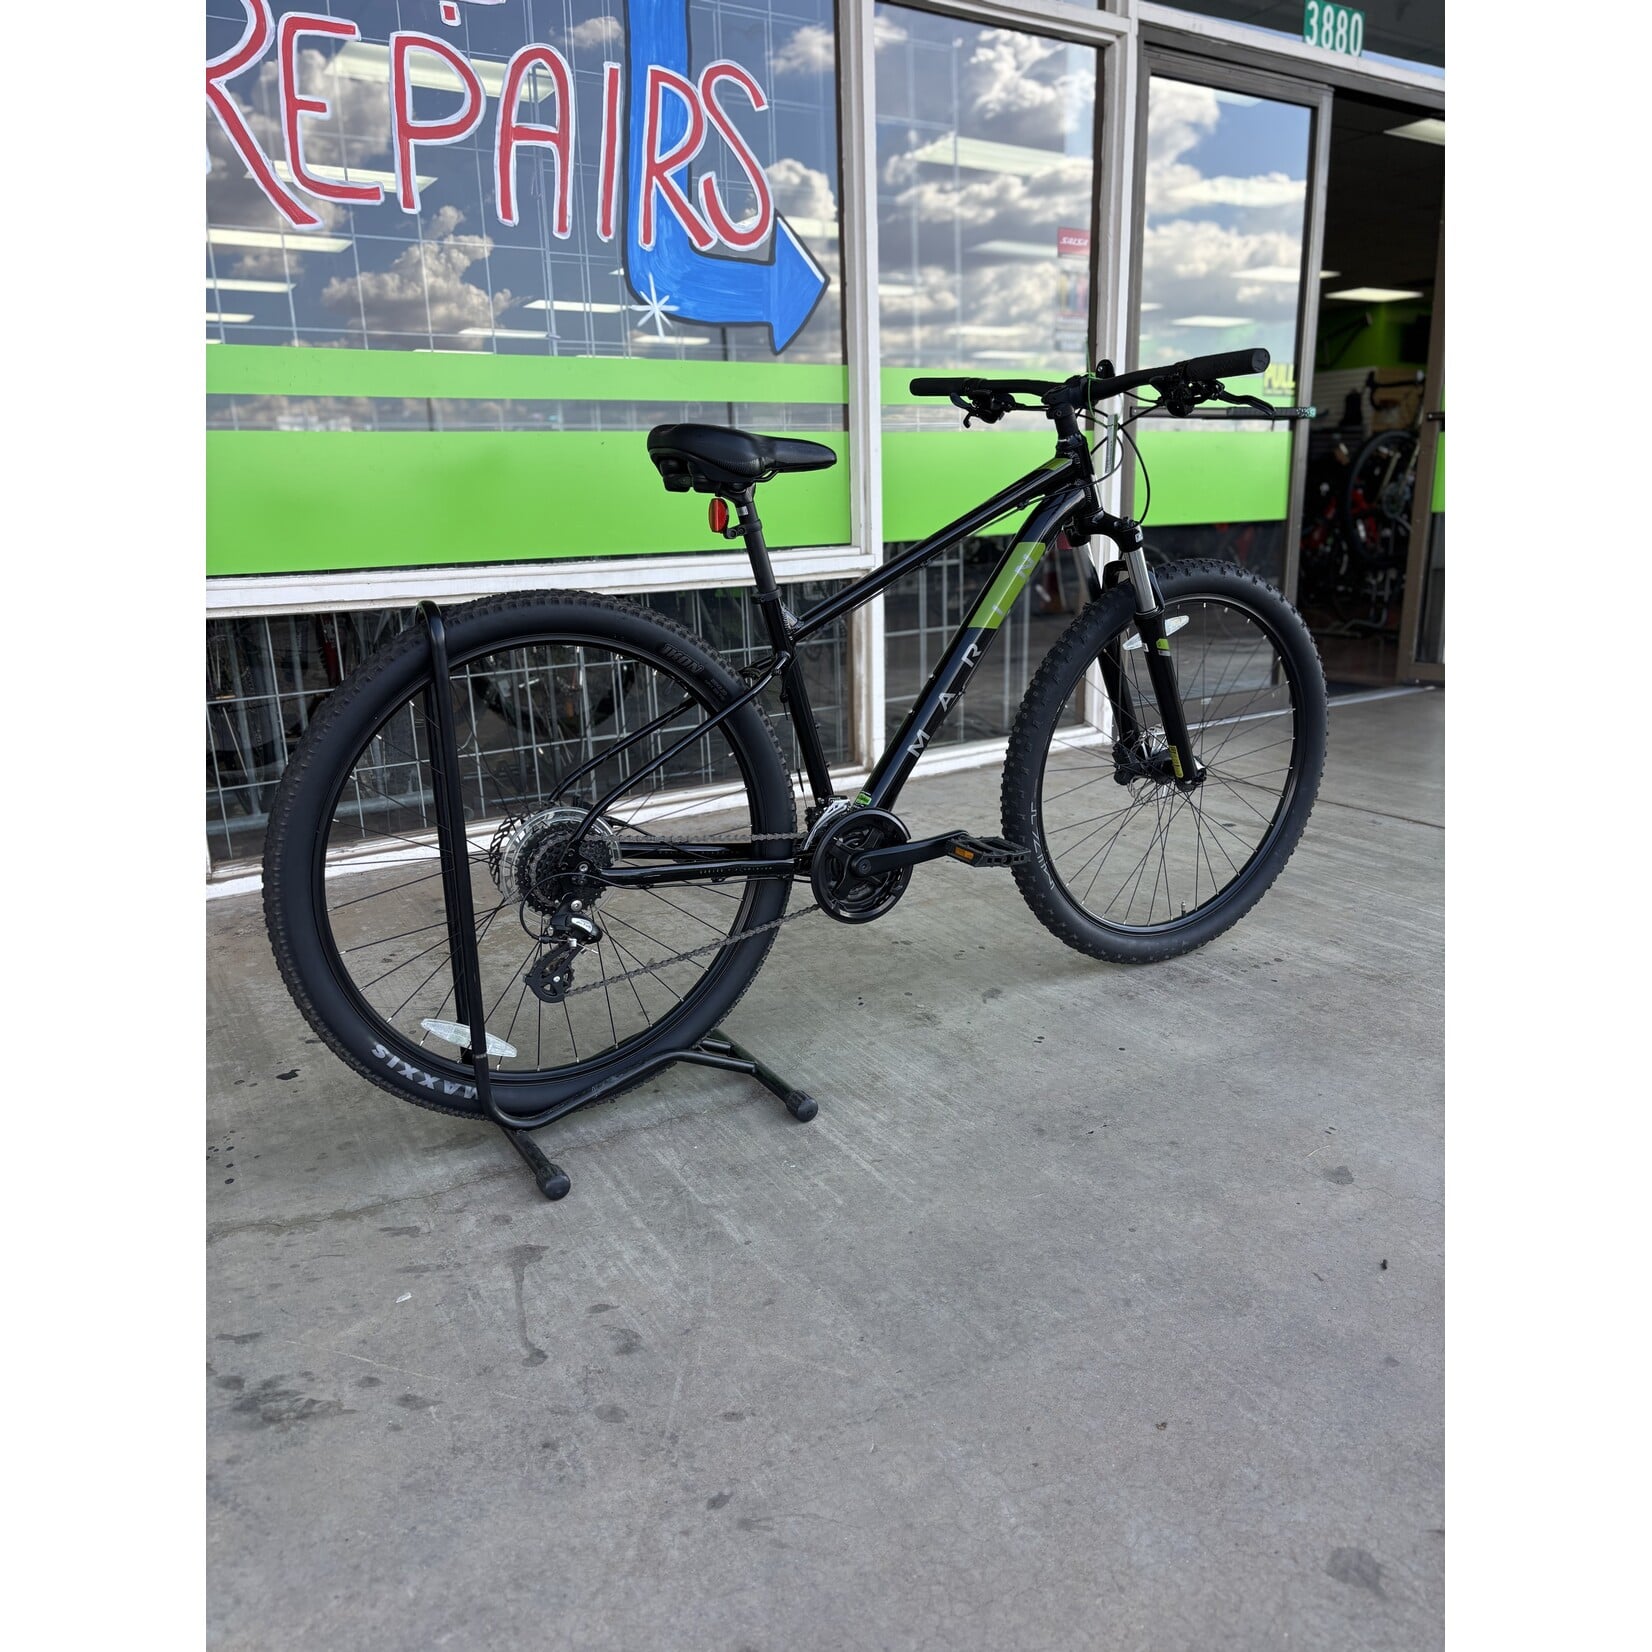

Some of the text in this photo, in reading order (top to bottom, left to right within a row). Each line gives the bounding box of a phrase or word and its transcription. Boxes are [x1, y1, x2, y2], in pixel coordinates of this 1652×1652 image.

[206, 0, 774, 252] REPAIRS
[1305, 0, 1363, 58] 3880
[907, 553, 1035, 758] MARIN
